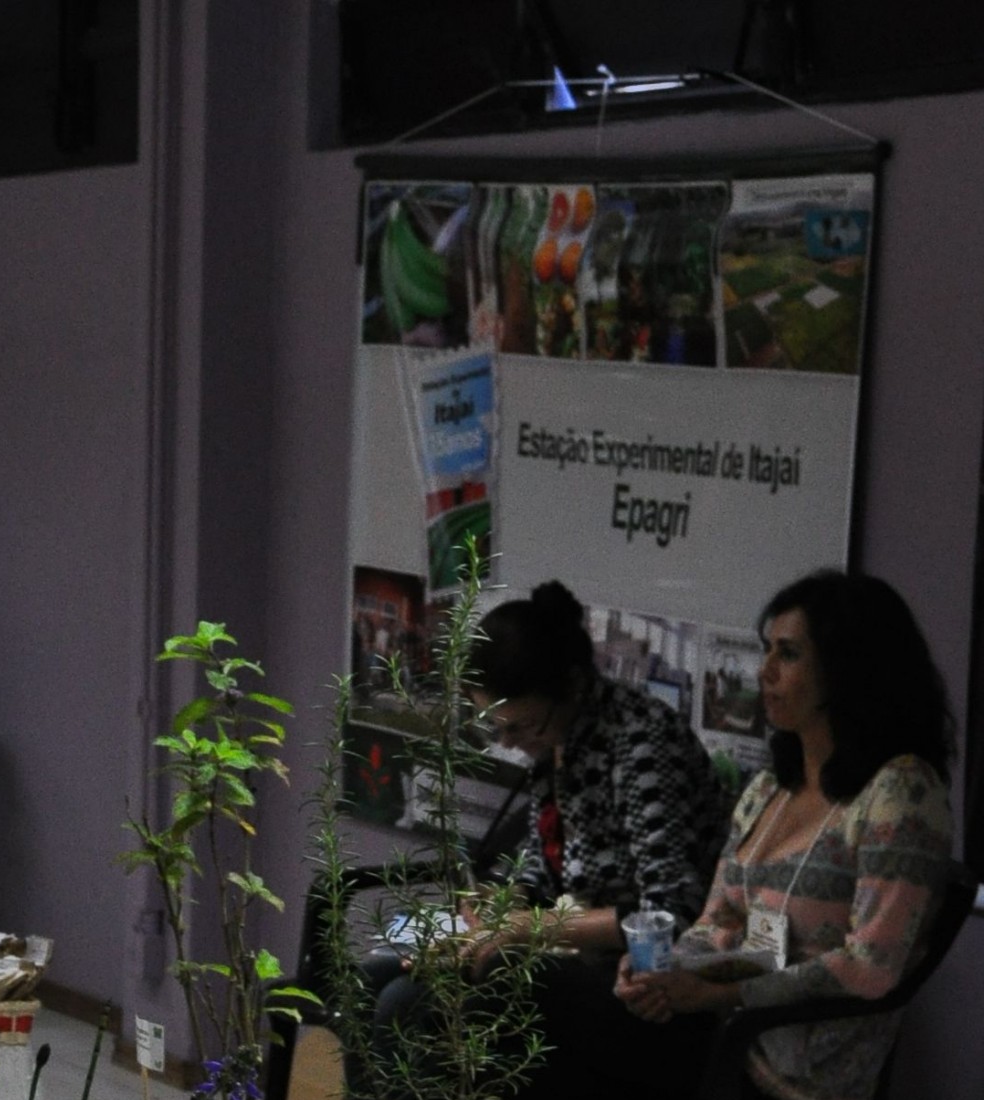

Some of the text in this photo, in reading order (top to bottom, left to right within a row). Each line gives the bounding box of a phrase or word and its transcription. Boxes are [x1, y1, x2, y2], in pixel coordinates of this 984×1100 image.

[517, 422, 589, 470] Estação
[592, 429, 719, 477] Experimental
[720, 442, 744, 476] de
[748, 444, 801, 494] Itajaí
[610, 484, 692, 548] Epagri
